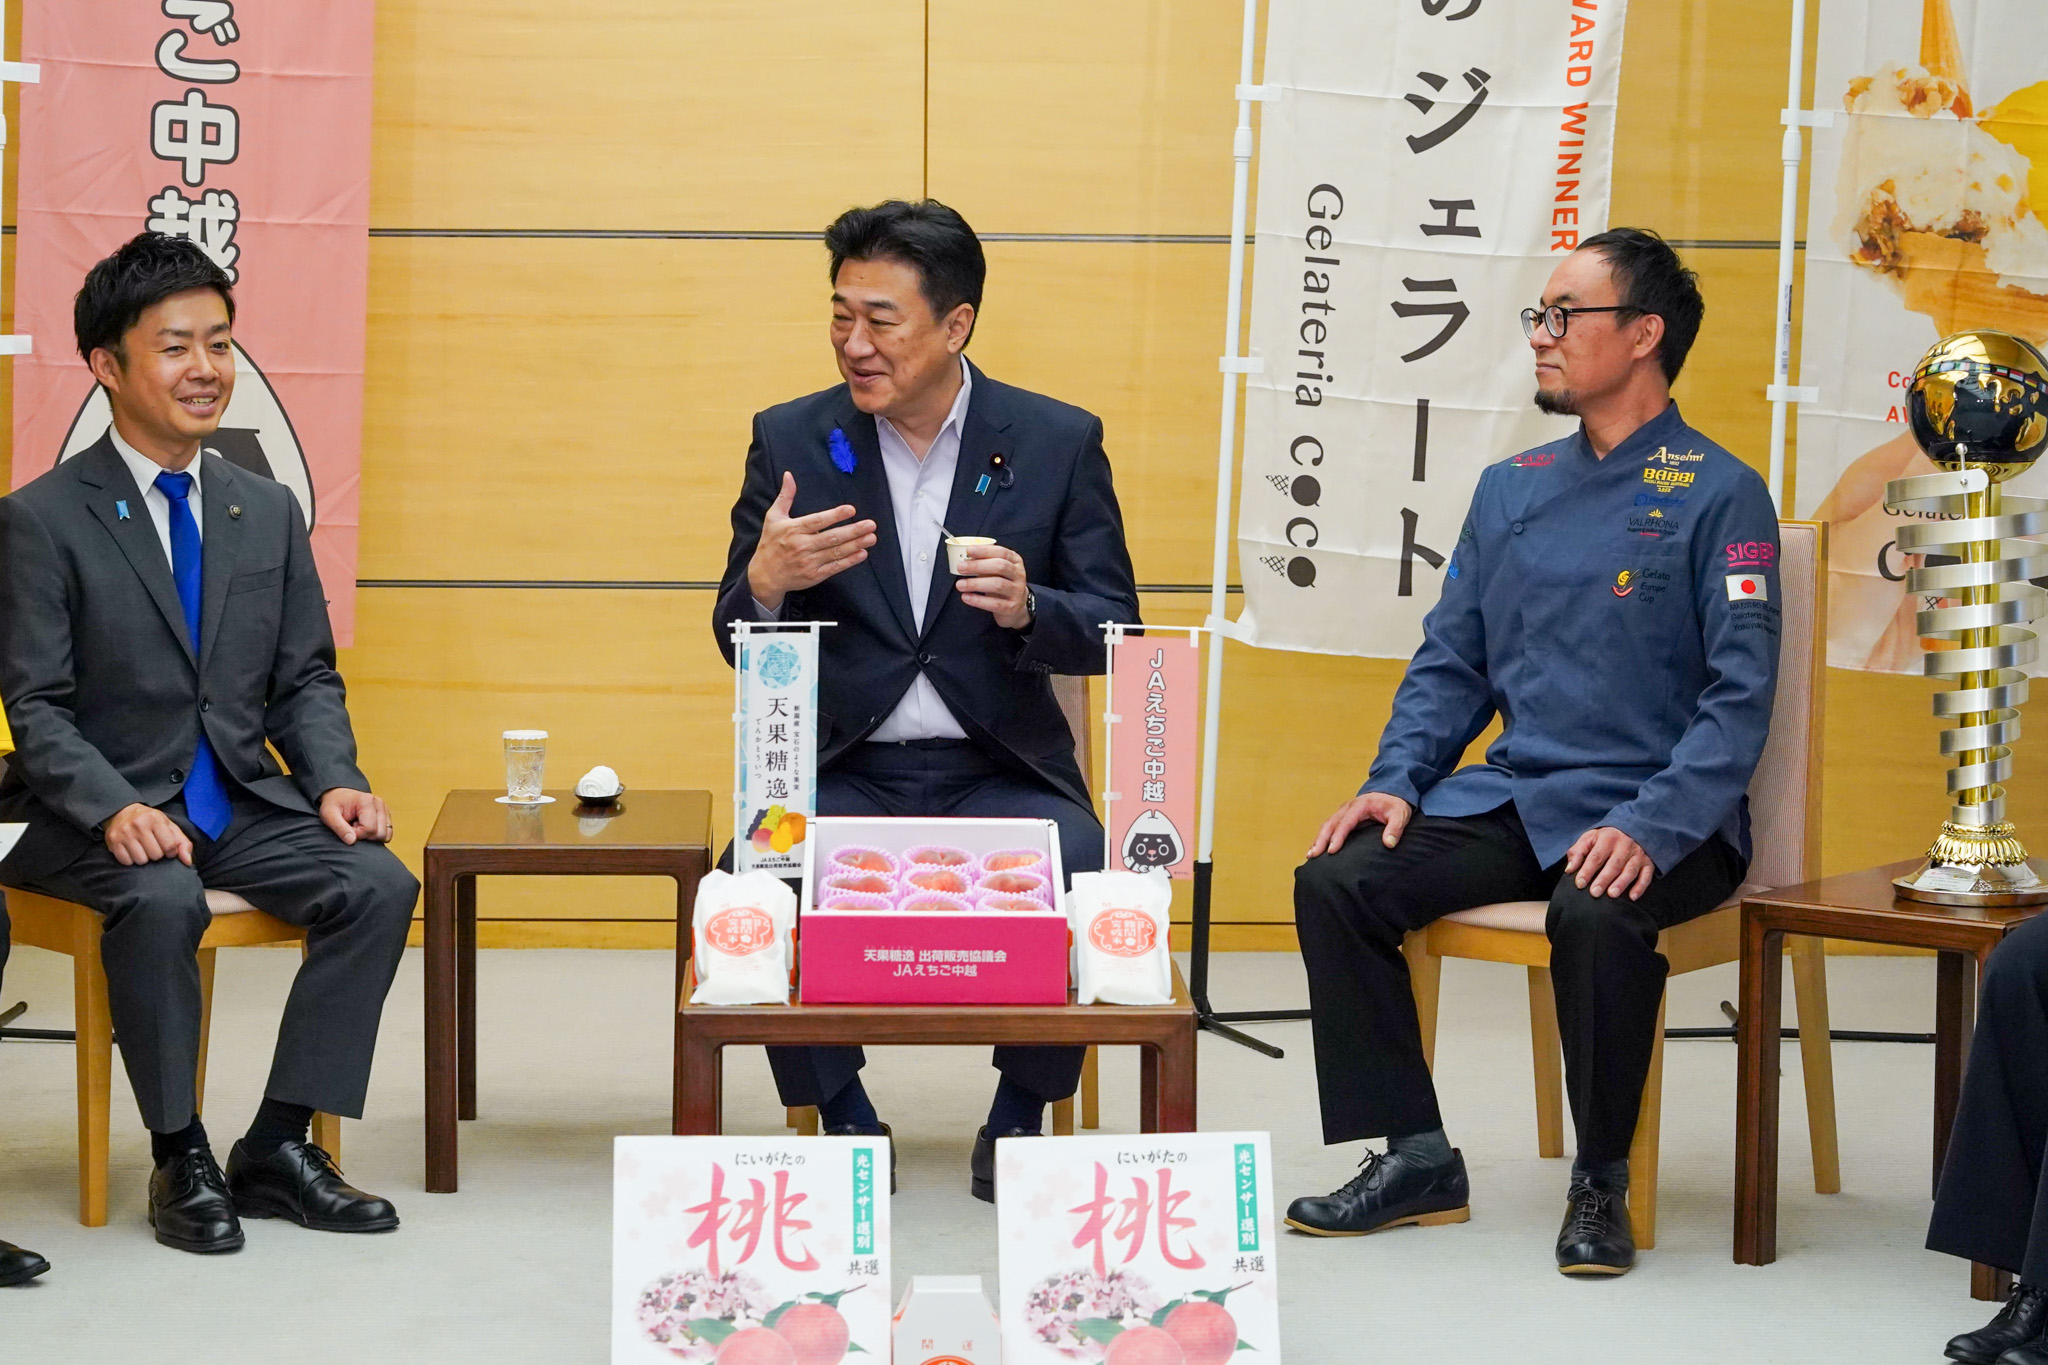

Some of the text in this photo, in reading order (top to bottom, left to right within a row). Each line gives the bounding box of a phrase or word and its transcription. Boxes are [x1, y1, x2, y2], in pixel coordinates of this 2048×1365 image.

[1550, 101, 1589, 252] WINNER
[1294, 183, 1344, 407] Gelateria
[1647, 446, 1705, 464] Anselmi
[1643, 467, 1696, 484] BABBI
[1628, 517, 1679, 531] VALRHONA
[1642, 568, 1671, 581] Gelato
[1640, 582, 1667, 594] Europe
[1638, 592, 1655, 604] Cup
[1142, 648, 1167, 803] JAえちご中越
[754, 718, 762, 780] てんかとういつ
[765, 697, 789, 799] 天果糖逸
[864, 949, 1008, 963] 天果糖逸 出荷販売協議会
[893, 964, 978, 977] JAえちご中越
[735, 1151, 806, 1166] にいがたの
[1117, 1149, 1188, 1165] にいがたの
[855, 1152, 871, 1250] 光センサー選別
[1237, 1148, 1256, 1246] 光センサー選別
[682, 1162, 821, 1281] 桃
[1066, 1161, 1206, 1282] 桃
[847, 1258, 880, 1276] 共選
[1232, 1255, 1265, 1273] 共選
